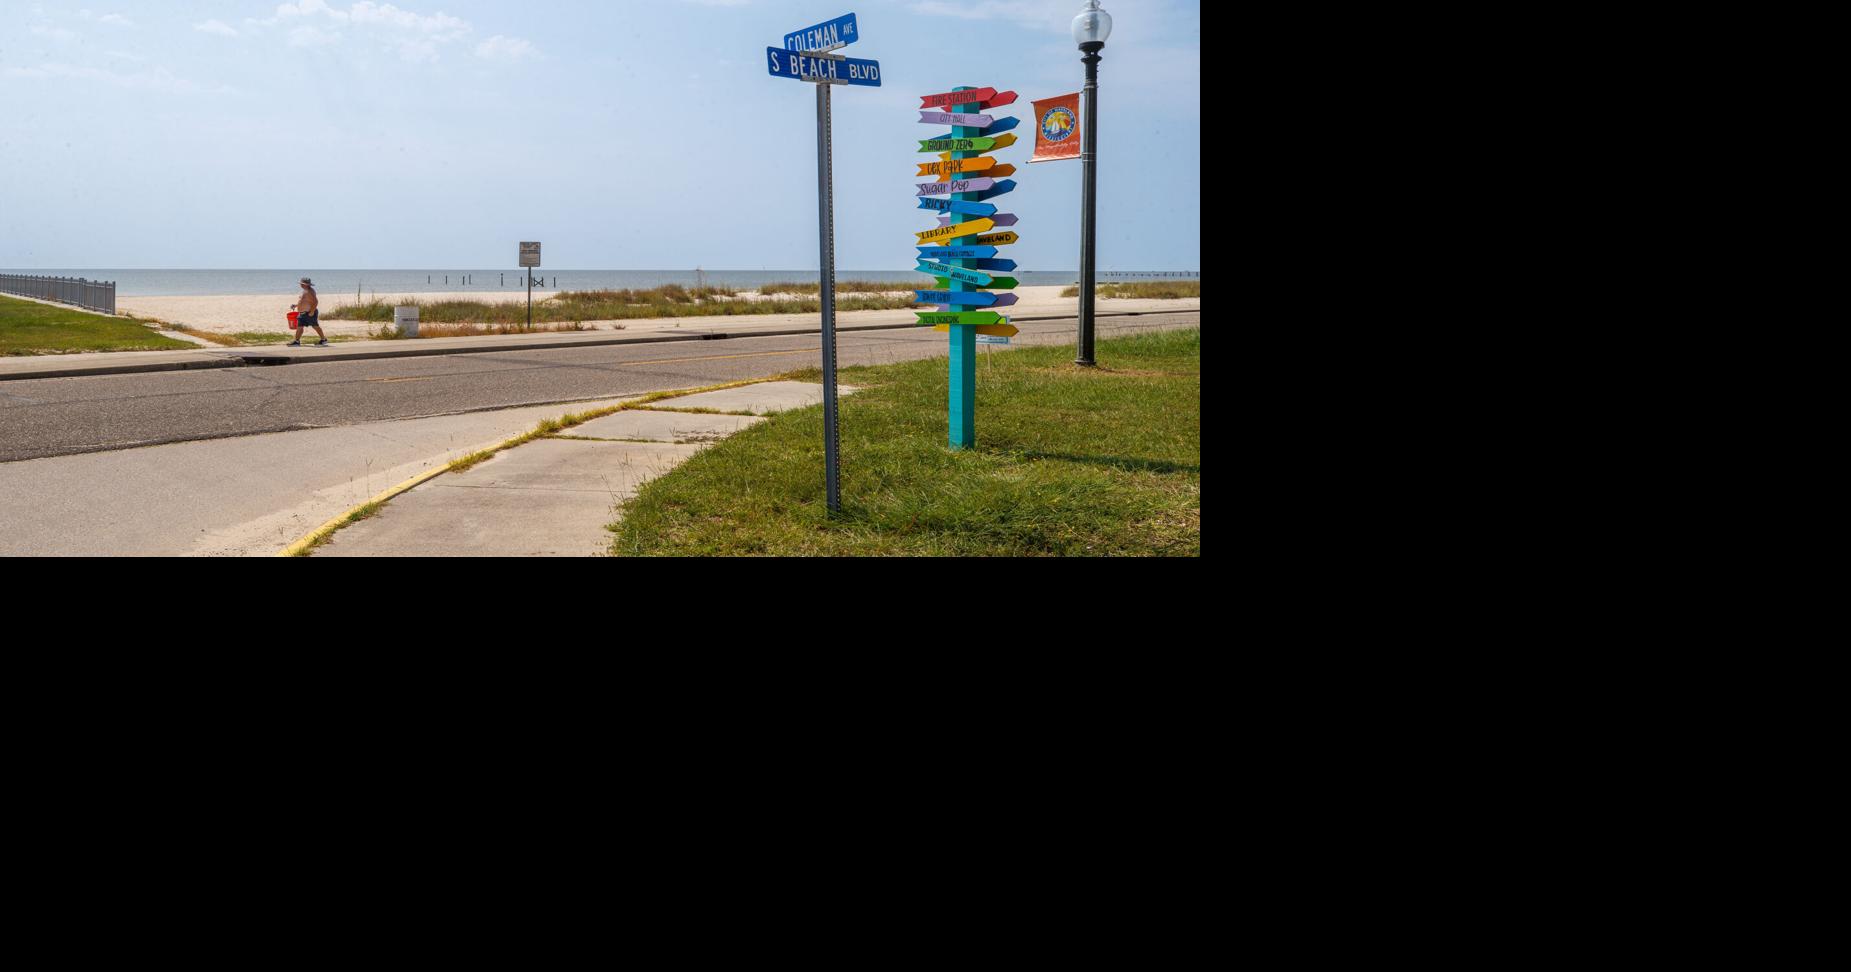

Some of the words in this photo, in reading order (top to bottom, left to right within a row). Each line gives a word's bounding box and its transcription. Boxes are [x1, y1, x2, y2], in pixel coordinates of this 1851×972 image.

[788, 23, 838, 52] COLEMAN
[843, 22, 854, 35] AVE
[771, 51, 780, 72] S
[790, 55, 837, 79] BEACH
[849, 64, 879, 80] BLVD
[932, 95, 947, 105] FIRE
[948, 91, 977, 103] STATION
[927, 140, 954, 151] GROUND
[920, 183, 948, 195] Sugar
[951, 180, 969, 192] Pop
[921, 225, 957, 239] LIBRARY
